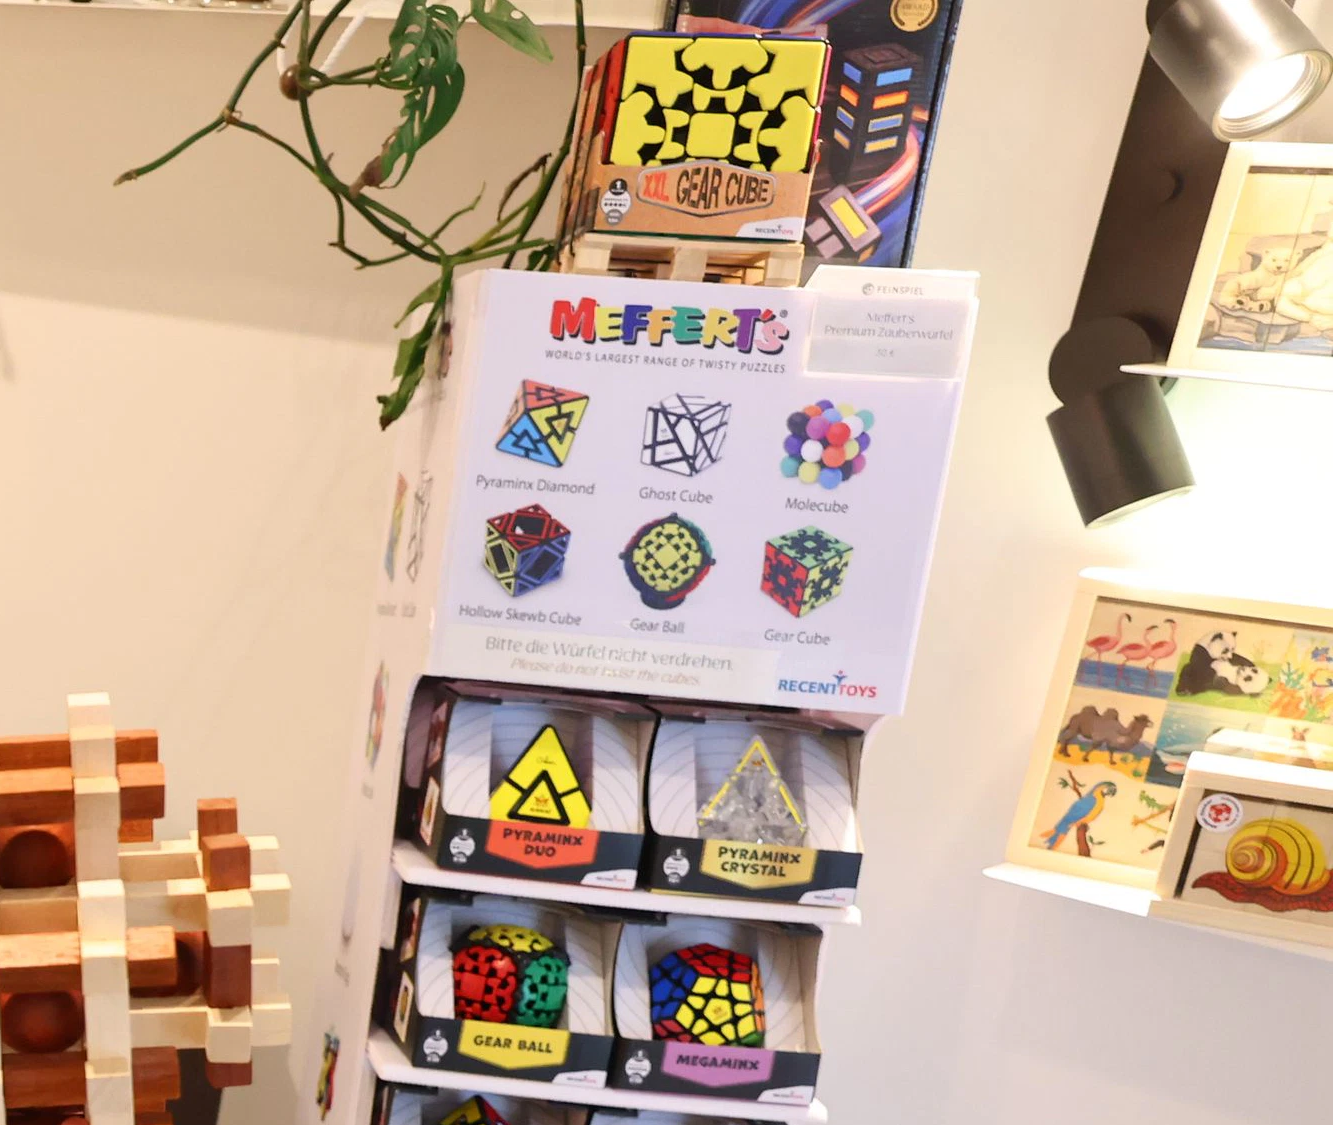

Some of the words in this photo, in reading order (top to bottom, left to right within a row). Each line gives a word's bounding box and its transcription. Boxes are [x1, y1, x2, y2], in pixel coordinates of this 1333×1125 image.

[644, 172, 669, 202] XXL
[676, 166, 722, 210] GEAR
[725, 173, 770, 205] CUBE
[877, 285, 924, 295] FEINSPIEL
[824, 325, 875, 337] Premium
[545, 350, 591, 362] WORLD'S
[594, 353, 639, 365] LARGEST
[643, 356, 678, 368] RANGE
[682, 359, 696, 368] OF
[698, 360, 737, 371] TWISTY
[740, 363, 786, 374] PUZZLES
[475, 475, 533, 492] Pyraminx
[536, 480, 595, 495] Diamond
[638, 487, 675, 502] Ghost
[677, 489, 713, 504] Cube
[785, 497, 848, 514] Molecube
[459, 604, 502, 619] Hollow
[506, 608, 546, 622] Skewb
[549, 612, 581, 626] Cube
[630, 619, 658, 633] Gear
[662, 620, 685, 634] Ball
[764, 629, 793, 643] Gear
[797, 631, 830, 645] Cube
[485, 636, 522, 653] Bitte
[525, 639, 549, 655] die
[552, 641, 606, 659] Würfel
[608, 645, 648, 663] nicht
[651, 651, 732, 671] verdrehen.
[503, 828, 583, 846] PYRAMINX
[524, 843, 557, 859] DUO
[718, 846, 802, 865] PYRAMINX
[720, 862, 787, 878] CRYSTAL
[474, 1035, 514, 1051] GEAR
[518, 1038, 553, 1054] BALL
[676, 1053, 760, 1072] MEGAMINX
